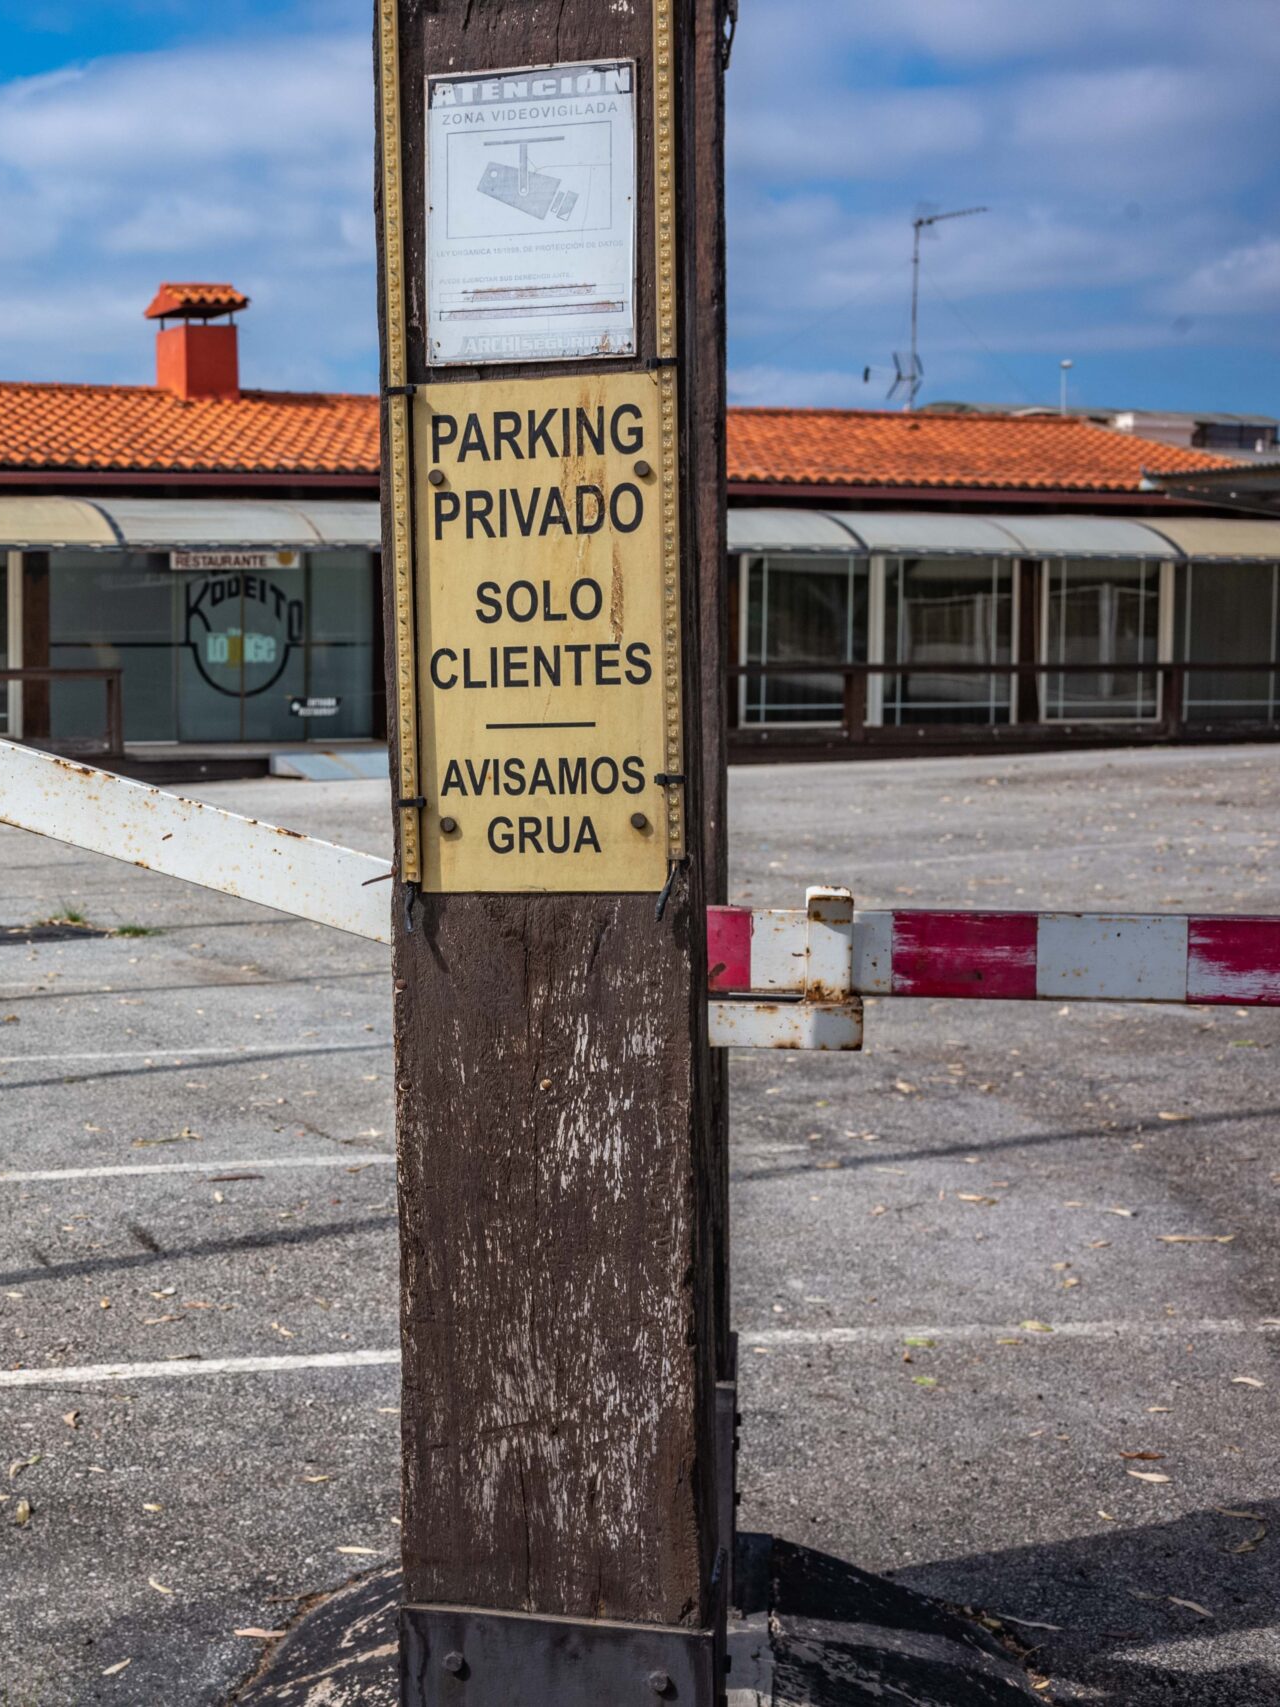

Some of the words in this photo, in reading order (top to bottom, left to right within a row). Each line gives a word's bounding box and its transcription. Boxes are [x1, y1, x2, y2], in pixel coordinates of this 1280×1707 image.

[442, 111, 485, 126] ZONA
[491, 101, 618, 122] VIDEOVIGILADA
[430, 403, 645, 464] PARKING
[434, 481, 645, 541] PRIVADO
[175, 555, 268, 568] RESTAURANTE
[475, 576, 603, 624] SOLO
[429, 641, 653, 691] CLIENTES
[440, 755, 646, 797] AVISAMOS
[487, 815, 602, 854] GRUA
